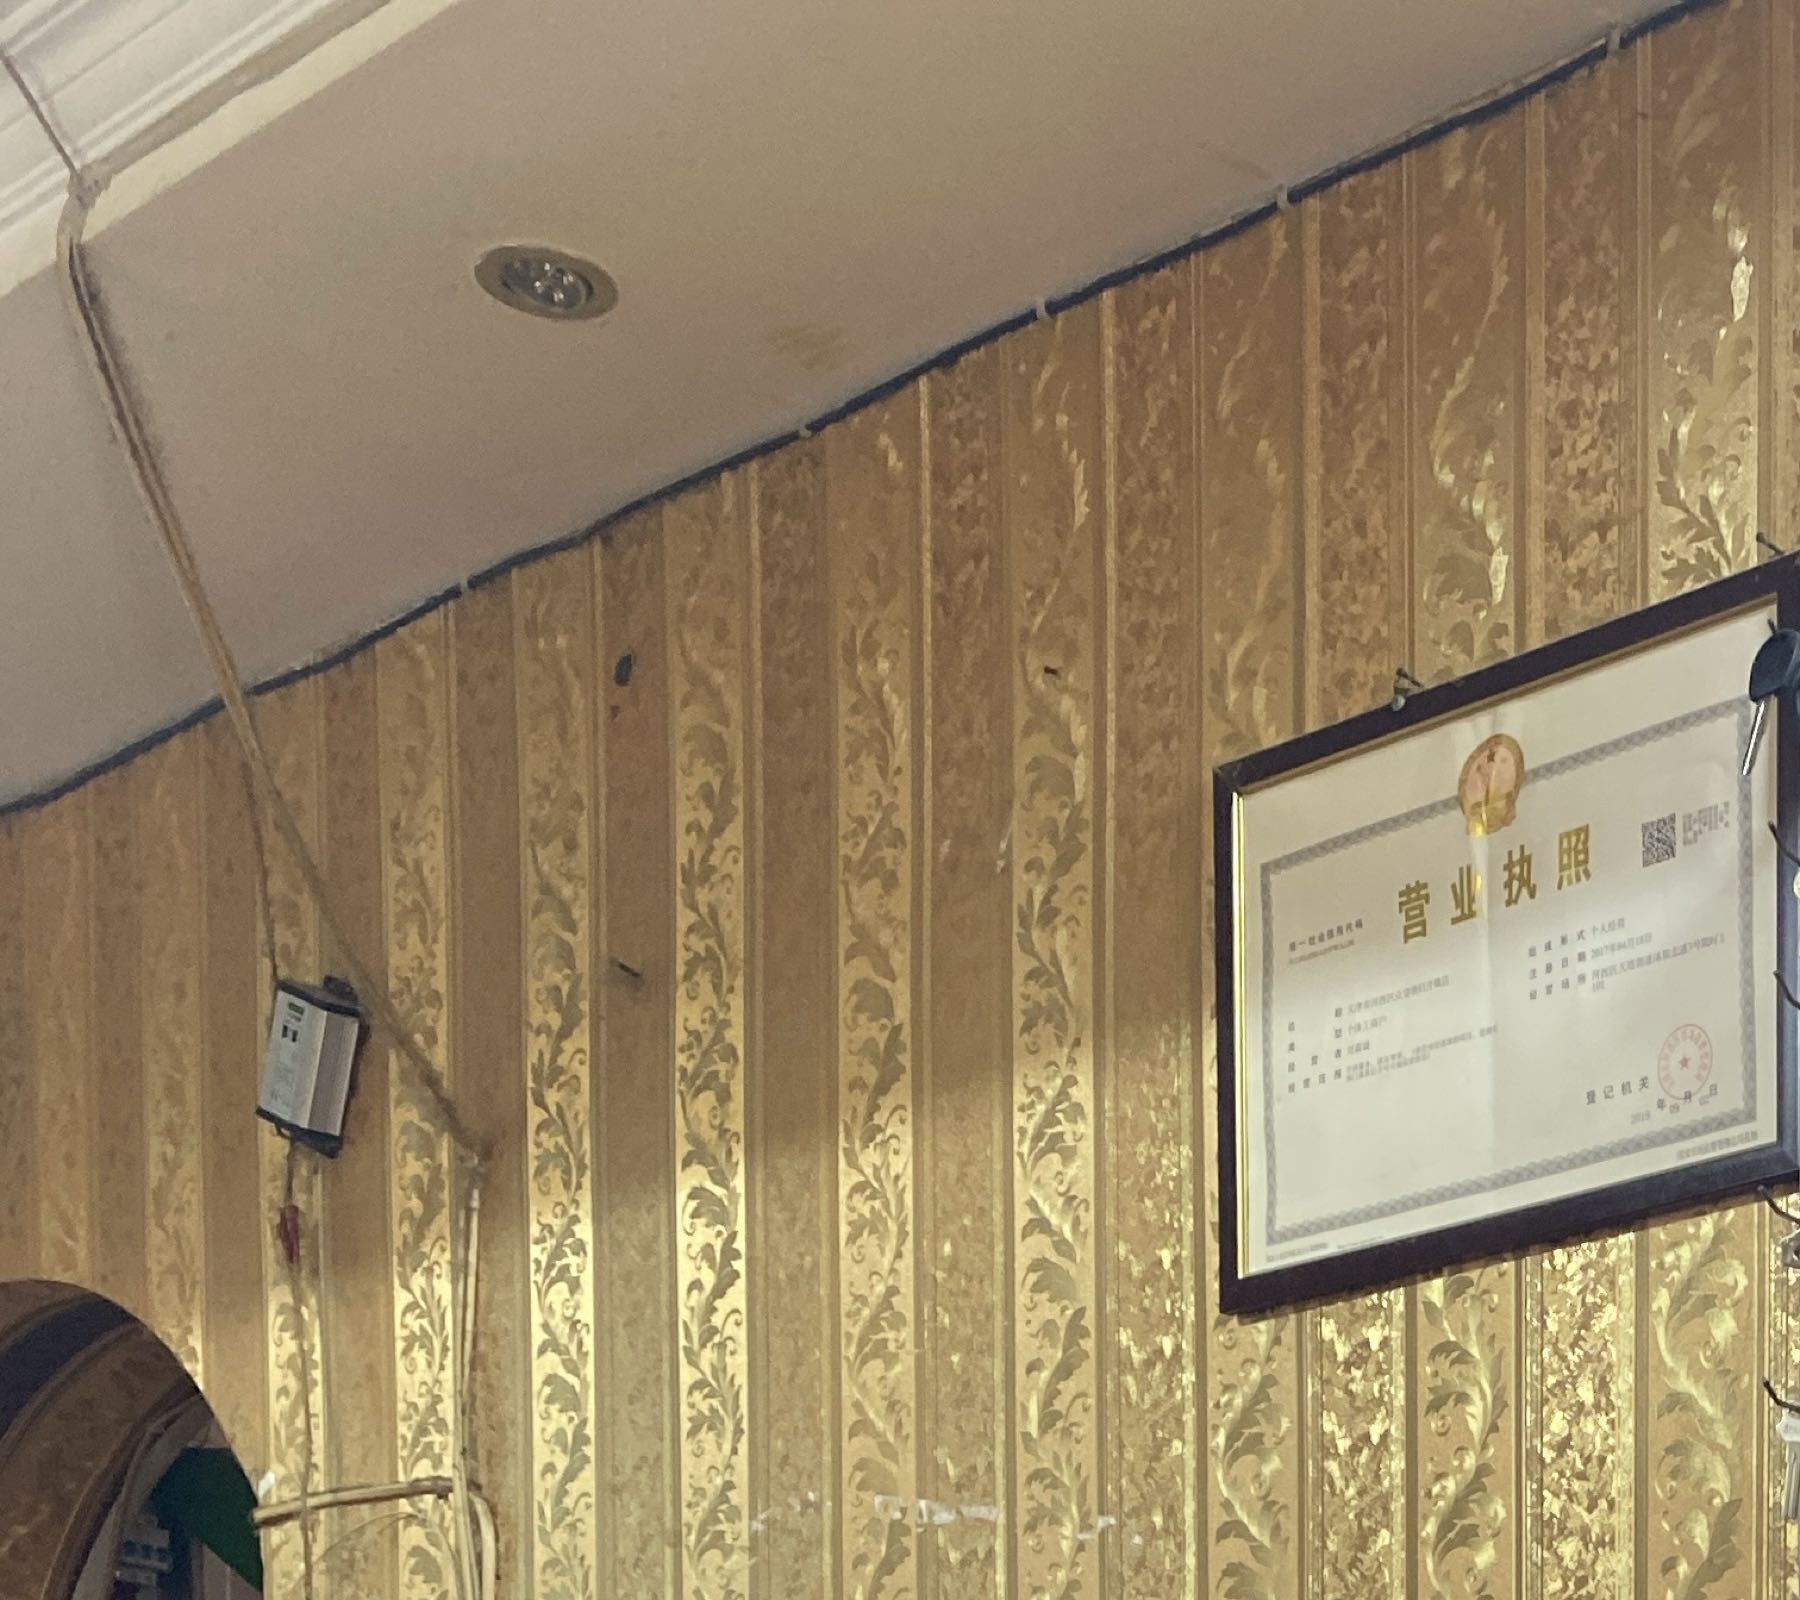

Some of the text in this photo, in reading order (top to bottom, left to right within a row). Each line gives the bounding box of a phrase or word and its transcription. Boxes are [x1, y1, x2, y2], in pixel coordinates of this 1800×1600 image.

[1398, 823, 1592, 945] 营业执照
[1586, 1076, 1649, 1105] 登记机关
